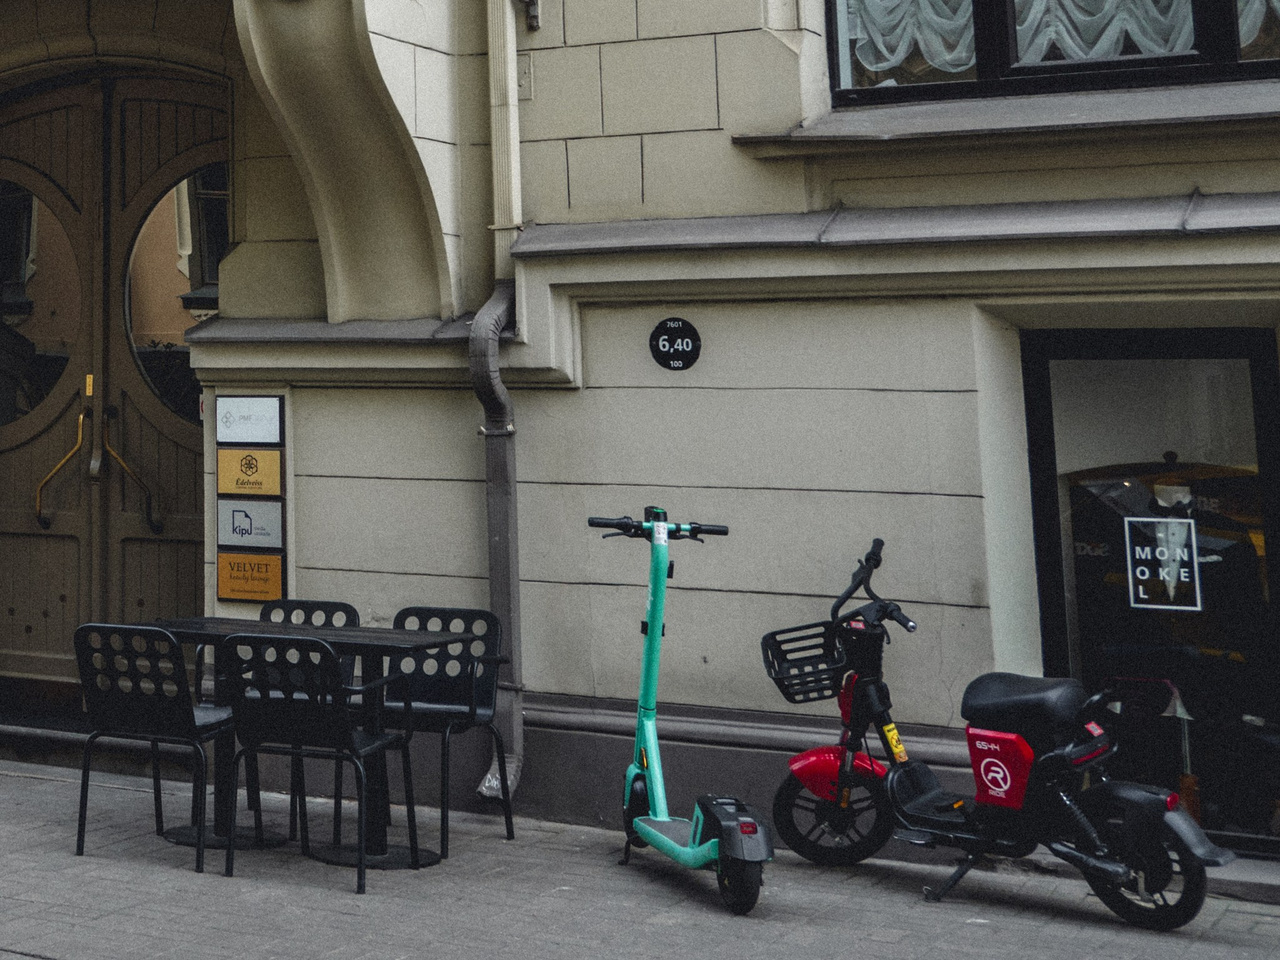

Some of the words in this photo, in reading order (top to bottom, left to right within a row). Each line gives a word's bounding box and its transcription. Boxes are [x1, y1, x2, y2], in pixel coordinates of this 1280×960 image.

[658, 335, 692, 353] 6,40
[670, 360, 683, 368] 100
[1135, 546, 1188, 560] MON
[228, 562, 270, 574] VELVET
[1136, 566, 1189, 582] OKE
[1138, 585, 1148, 599] L
[976, 741, 1000, 751] 6544
